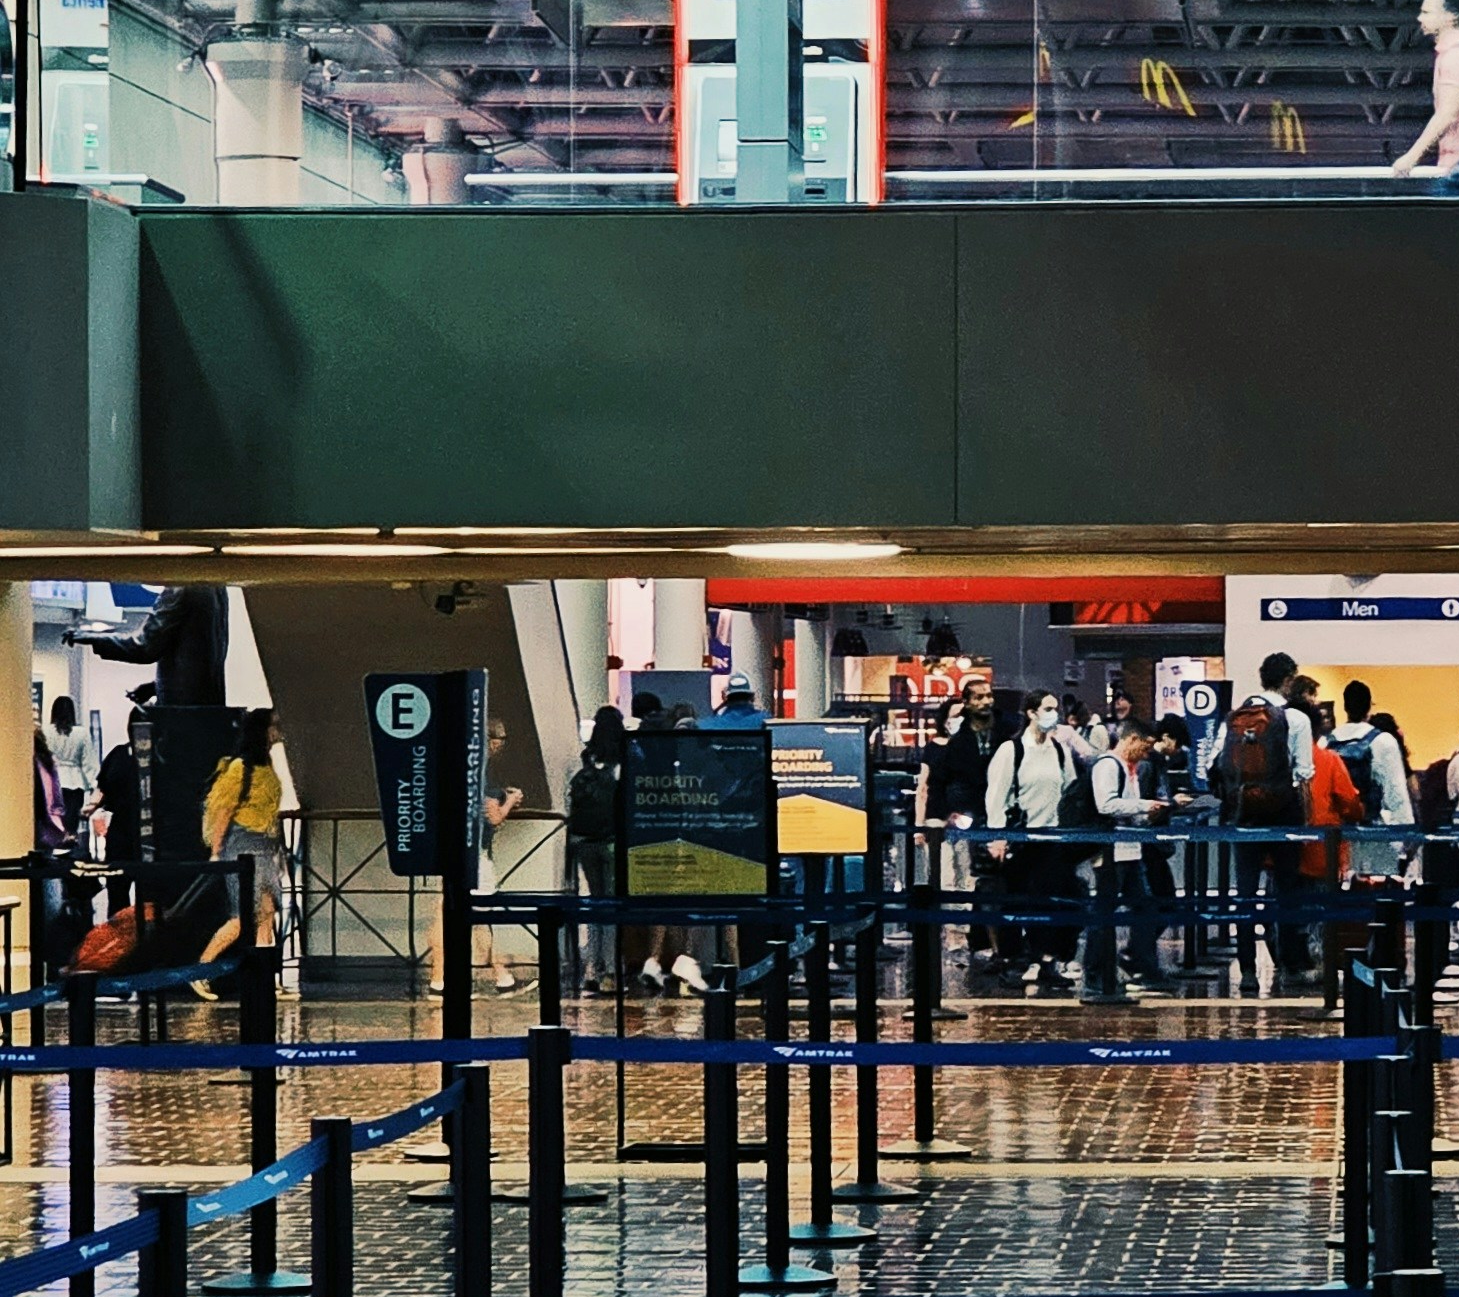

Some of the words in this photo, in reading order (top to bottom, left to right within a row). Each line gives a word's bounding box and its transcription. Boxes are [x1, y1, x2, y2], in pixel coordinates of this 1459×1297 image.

[1341, 600, 1379, 617] Men
[1194, 690, 1210, 710] D
[391, 692, 415, 730] E
[771, 748, 824, 761] PRIORITY
[771, 761, 834, 774] BOARDING
[412, 744, 427, 834] BOARDING
[634, 774, 704, 789] PRIORITY
[634, 791, 720, 806] BOARDING
[397, 778, 412, 853] PRIORITY
[0, 1053, 36, 1061] TRAK
[298, 1049, 358, 1058] AMTRAK
[794, 1049, 853, 1058] AMTRAK
[1111, 1049, 1171, 1058] AMTRAK
